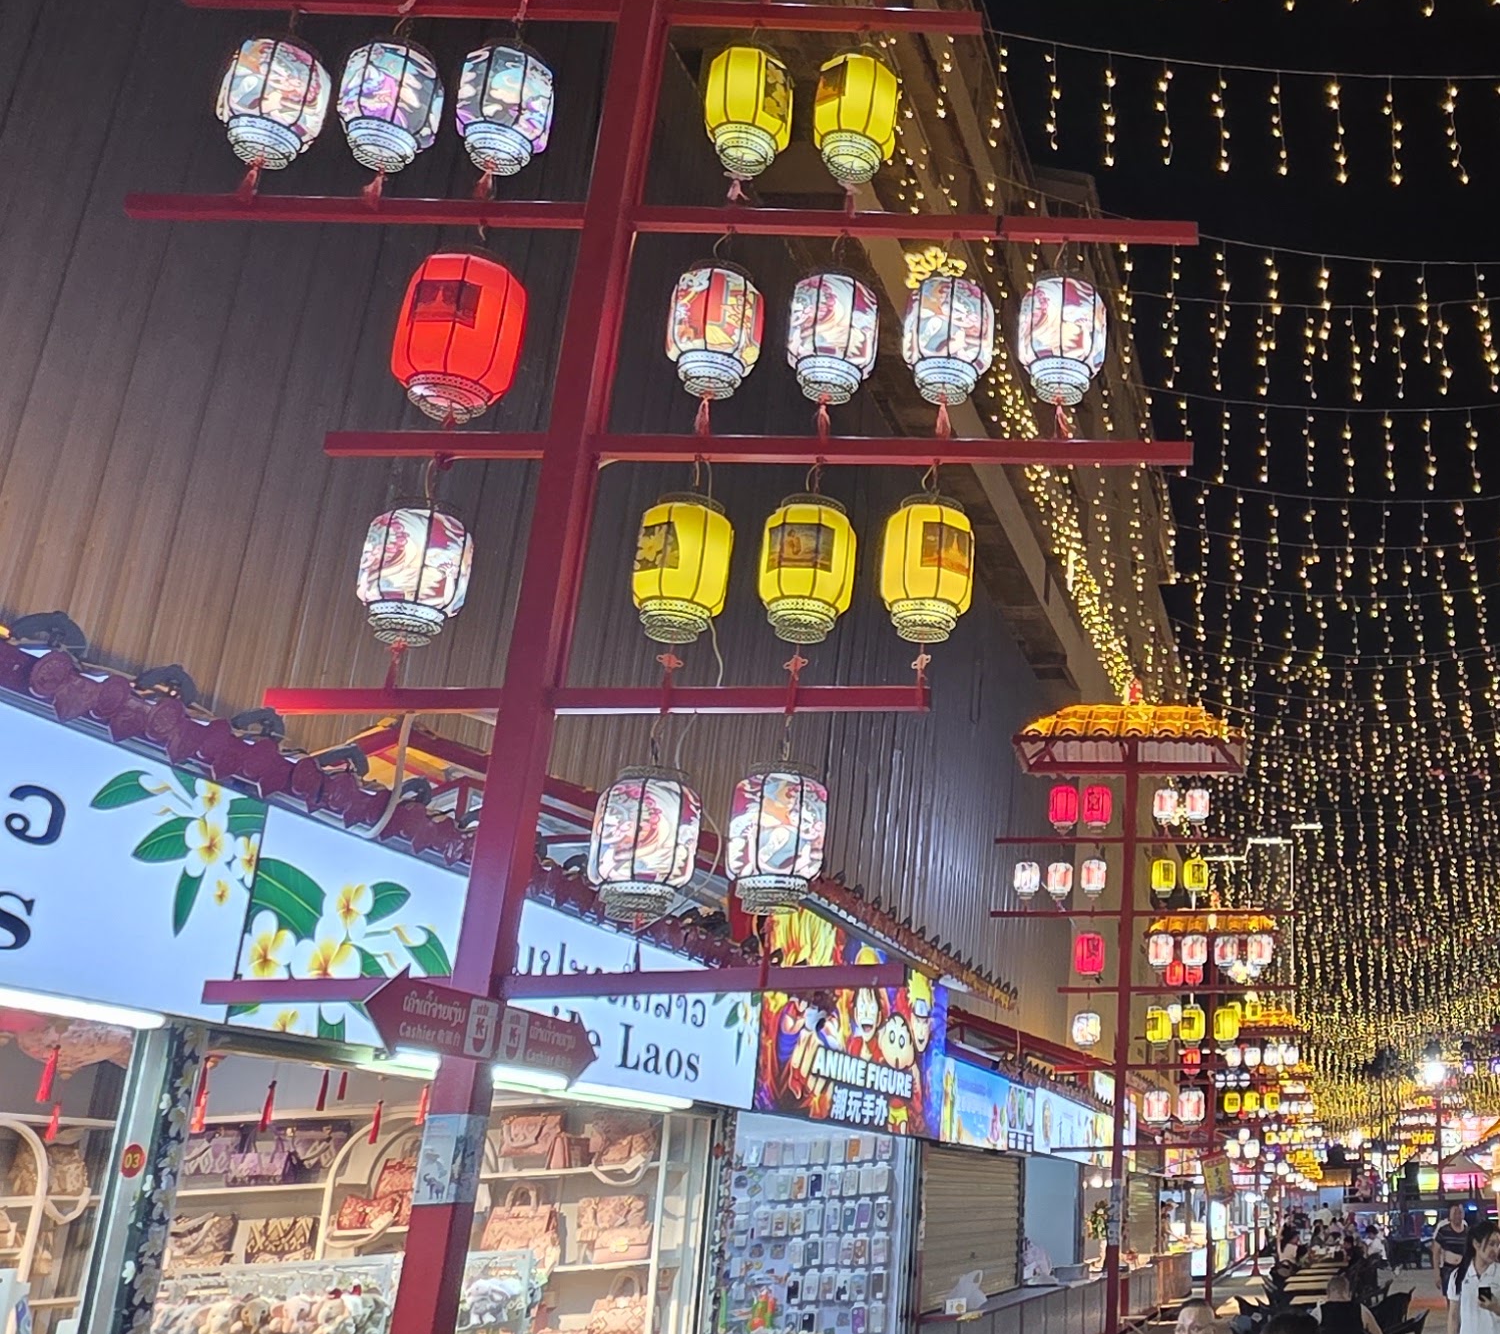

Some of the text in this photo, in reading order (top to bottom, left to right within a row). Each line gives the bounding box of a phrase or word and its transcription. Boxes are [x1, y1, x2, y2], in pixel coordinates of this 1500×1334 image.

[399, 1022, 436, 1042] Cashier
[614, 1022, 701, 1082] Laos
[811, 1045, 867, 1088] ANIME
[866, 1061, 914, 1099] FIGURE
[124, 1152, 141, 1169] 03
